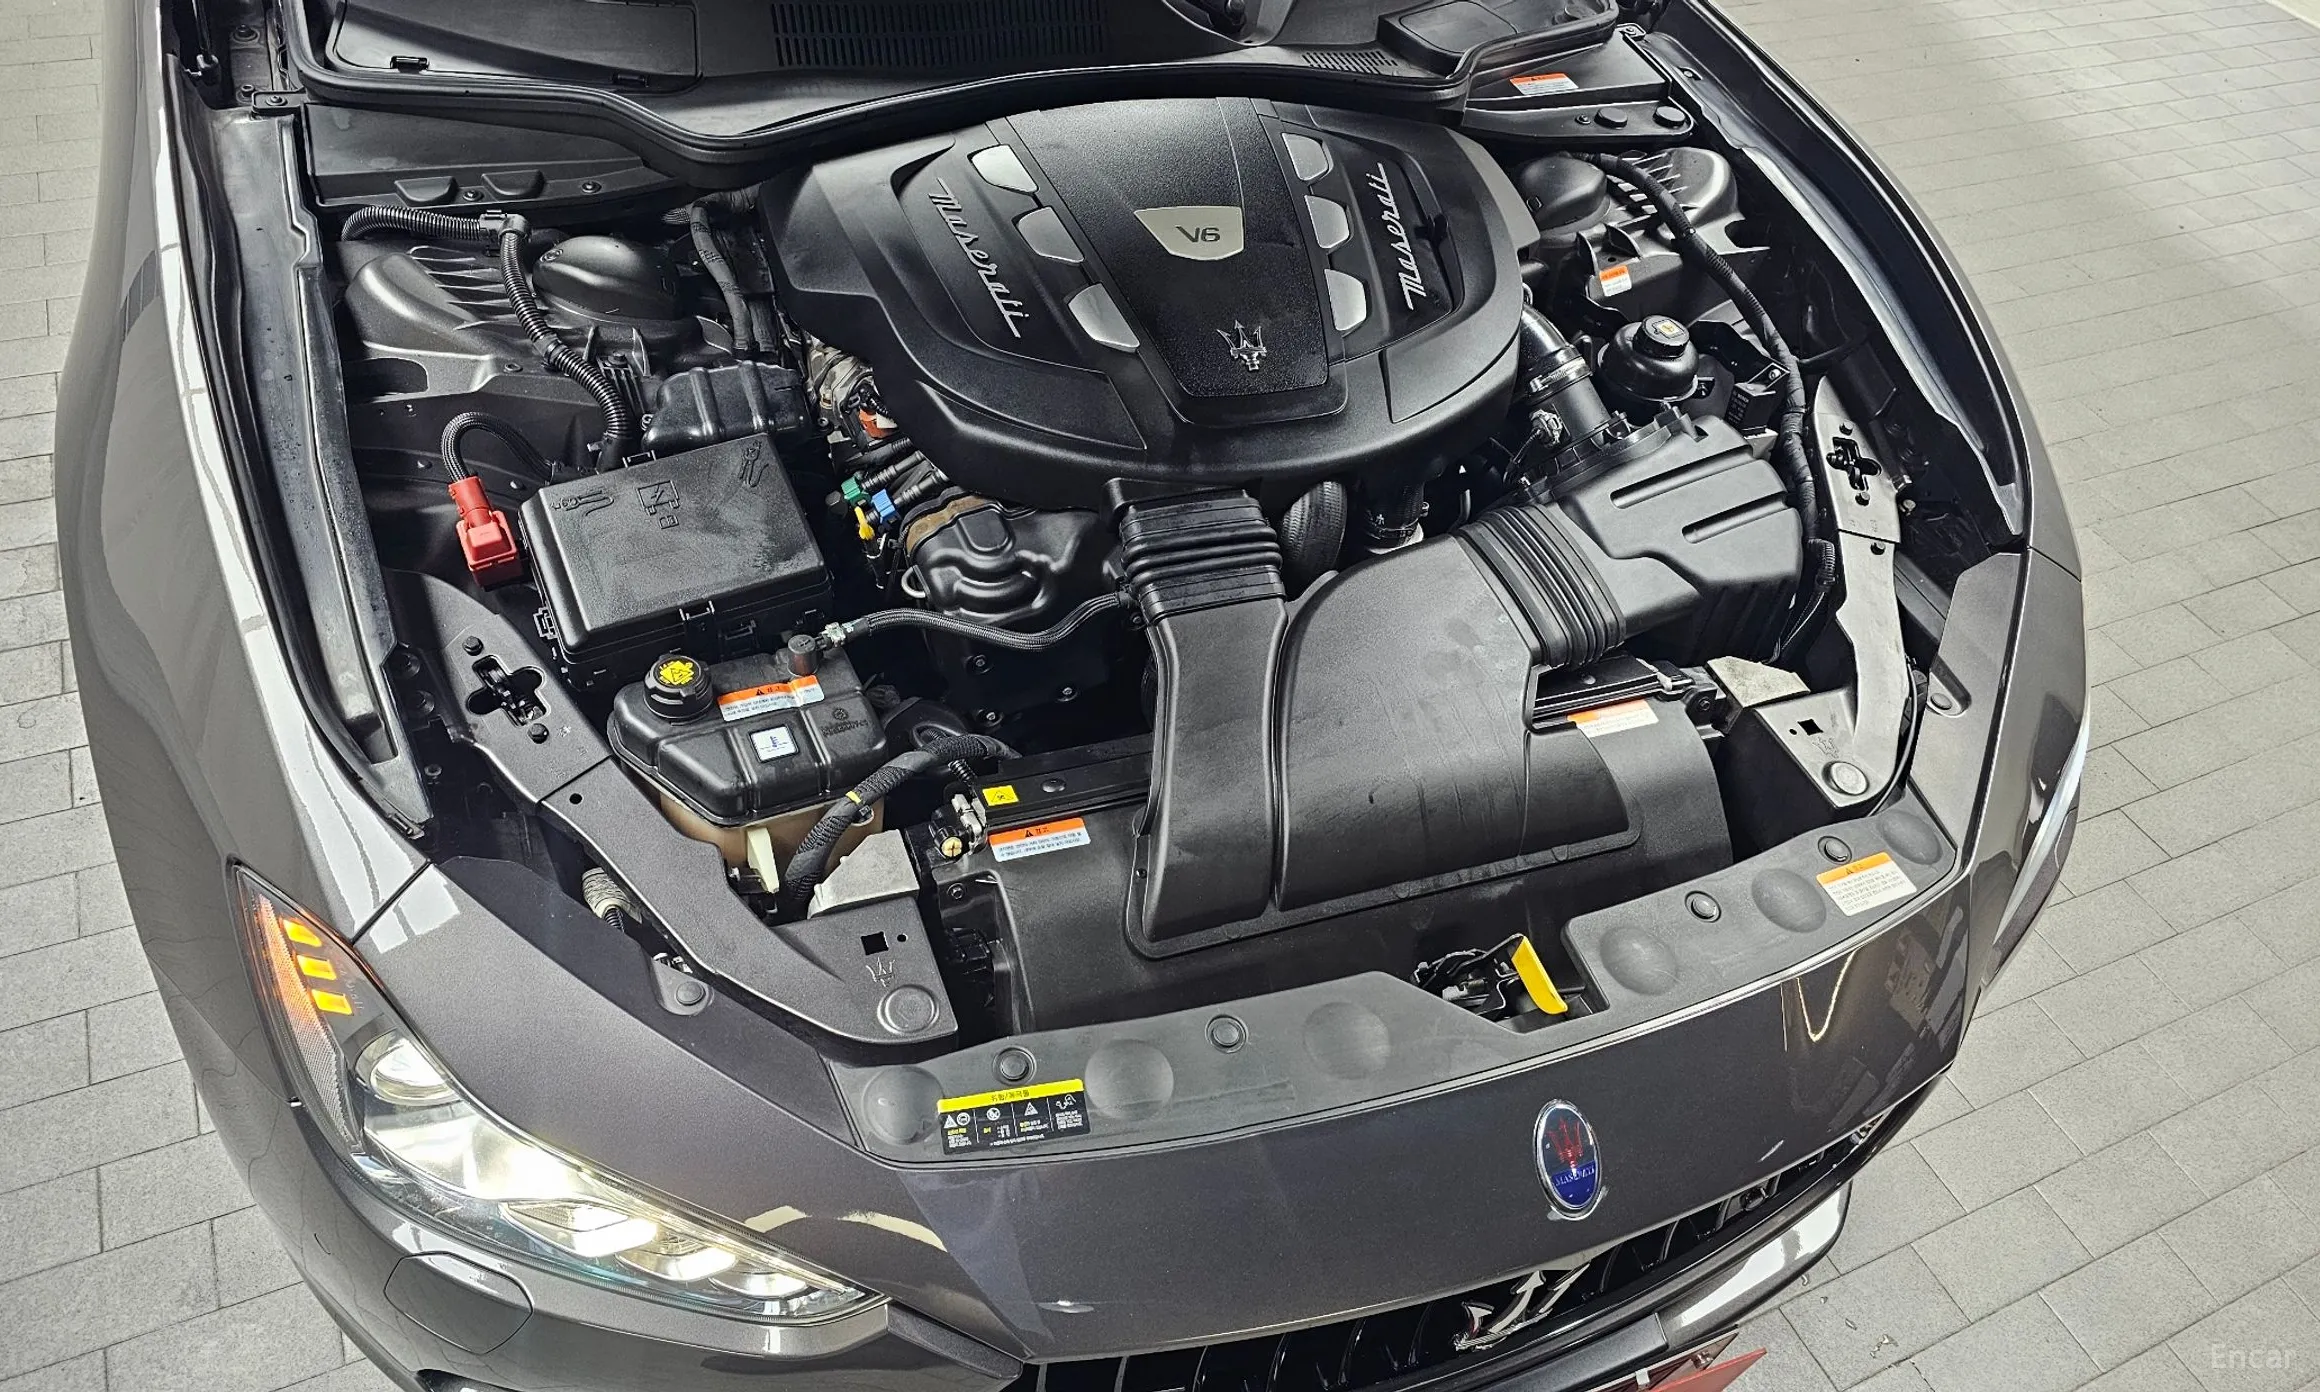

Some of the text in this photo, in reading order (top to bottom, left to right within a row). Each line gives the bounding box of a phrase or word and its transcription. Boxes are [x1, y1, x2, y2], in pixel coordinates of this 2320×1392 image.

[928, 177, 1030, 339] Maserati
[1175, 225, 1221, 243] V6
[1365, 162, 1427, 311] Maserati
